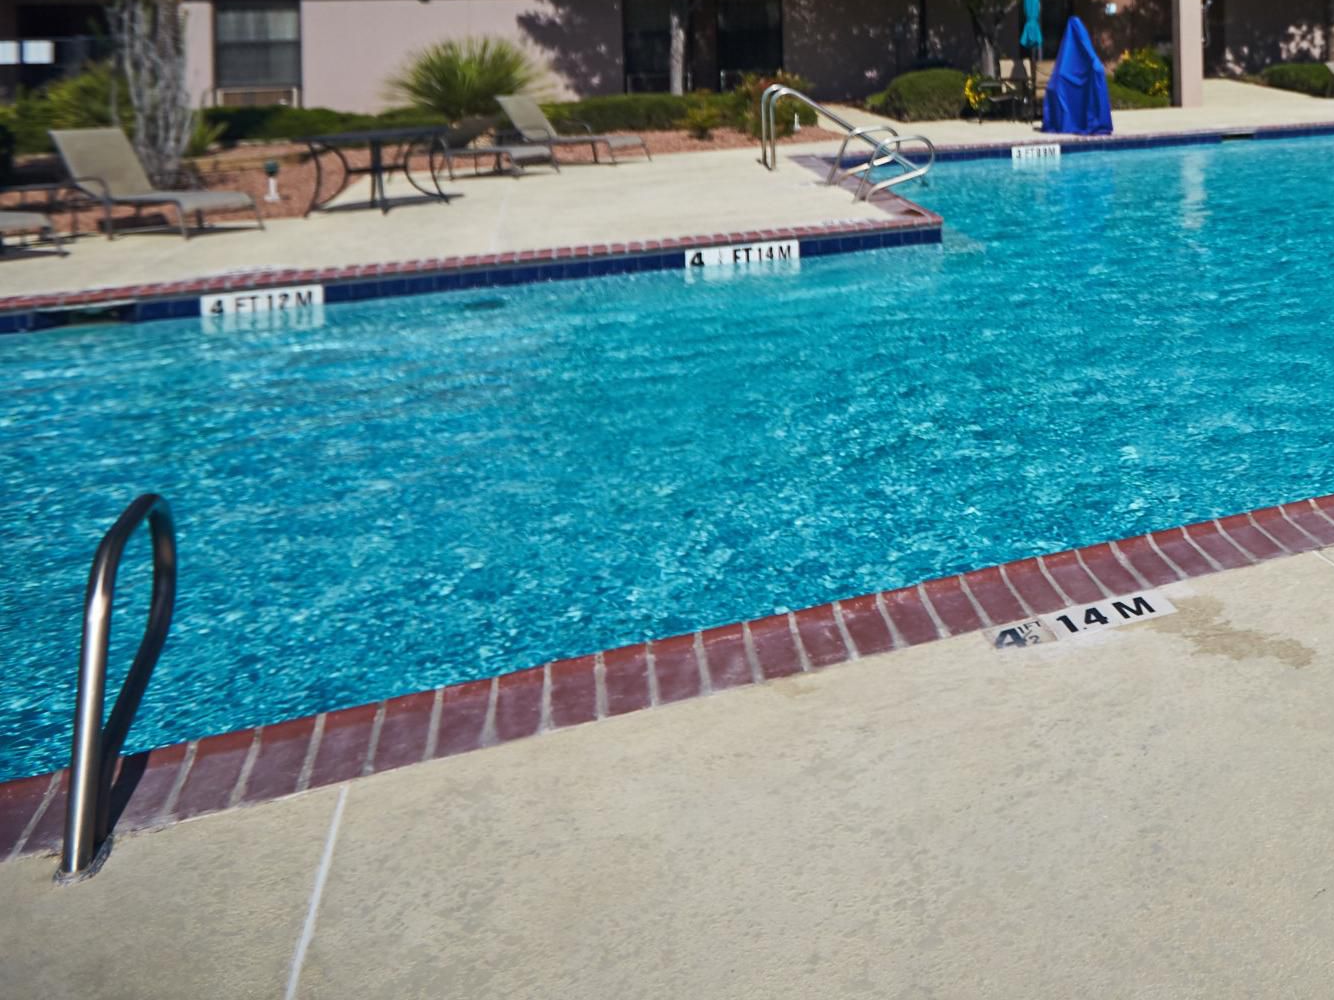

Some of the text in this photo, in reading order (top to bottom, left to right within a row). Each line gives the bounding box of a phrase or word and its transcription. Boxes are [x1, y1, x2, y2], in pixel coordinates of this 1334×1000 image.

[690, 251, 705, 266] 4
[732, 247, 752, 264] FT
[778, 245, 791, 260] M
[210, 299, 224, 314] 4
[235, 296, 259, 313] FT
[295, 290, 312, 307] M
[1112, 596, 1156, 620] M
